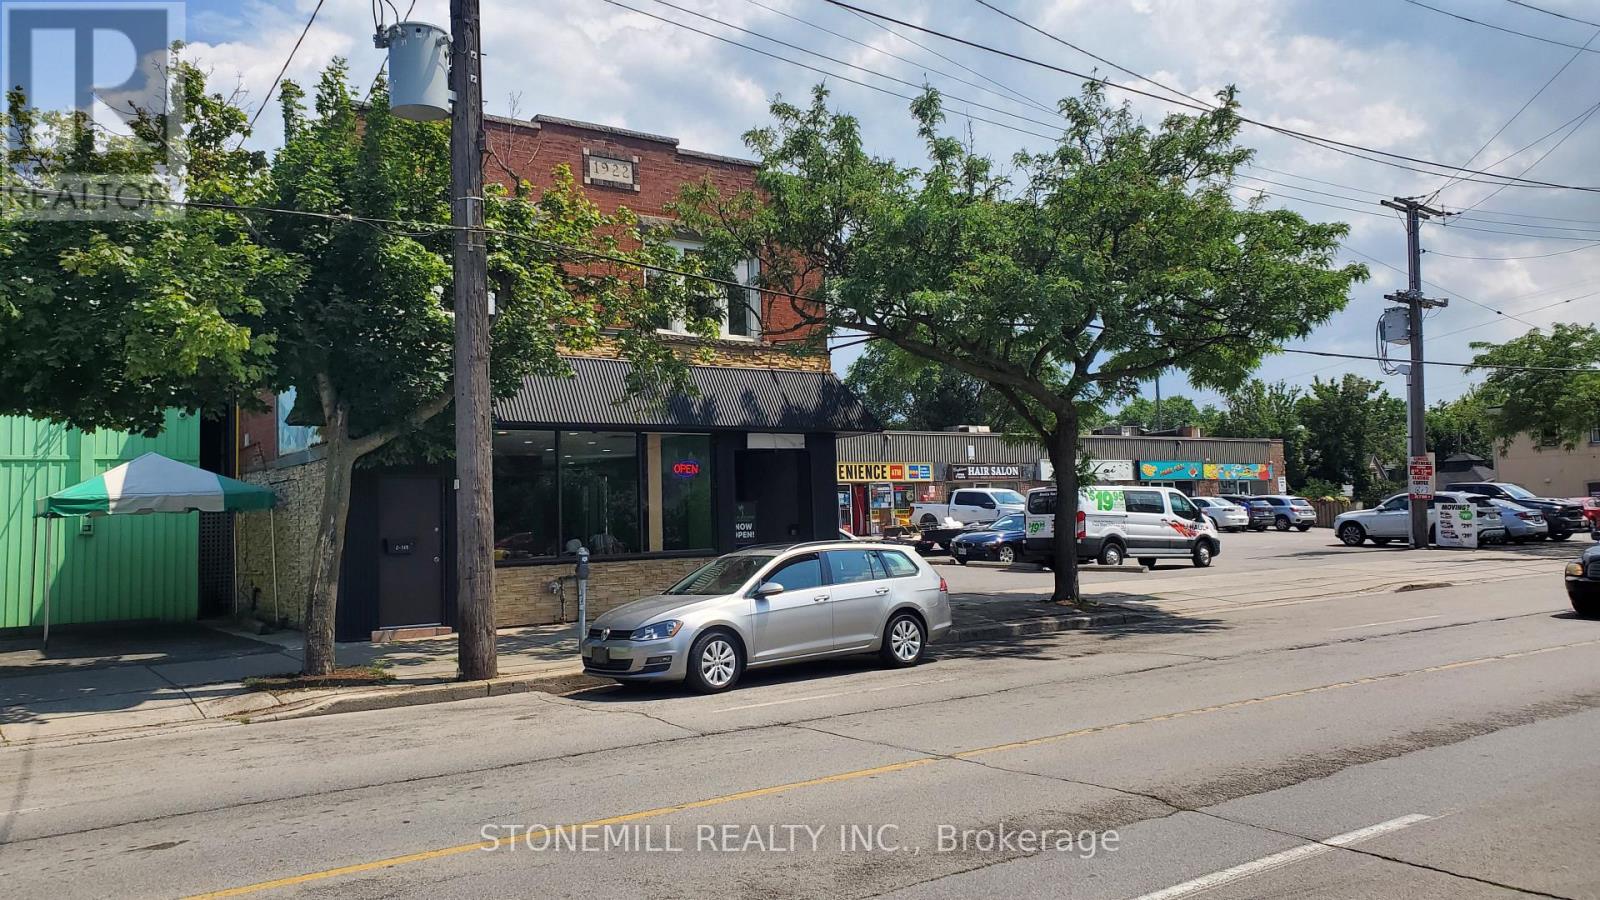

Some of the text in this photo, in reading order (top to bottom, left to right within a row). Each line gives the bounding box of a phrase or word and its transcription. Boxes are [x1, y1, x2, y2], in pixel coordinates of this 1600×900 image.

[593, 161, 630, 179] 1922
[673, 463, 699, 474] OPEN
[838, 464, 887, 480] ENIENCE
[967, 466, 990, 476] HAIR
[991, 466, 1019, 476] SALON
[736, 523, 753, 531] NOW
